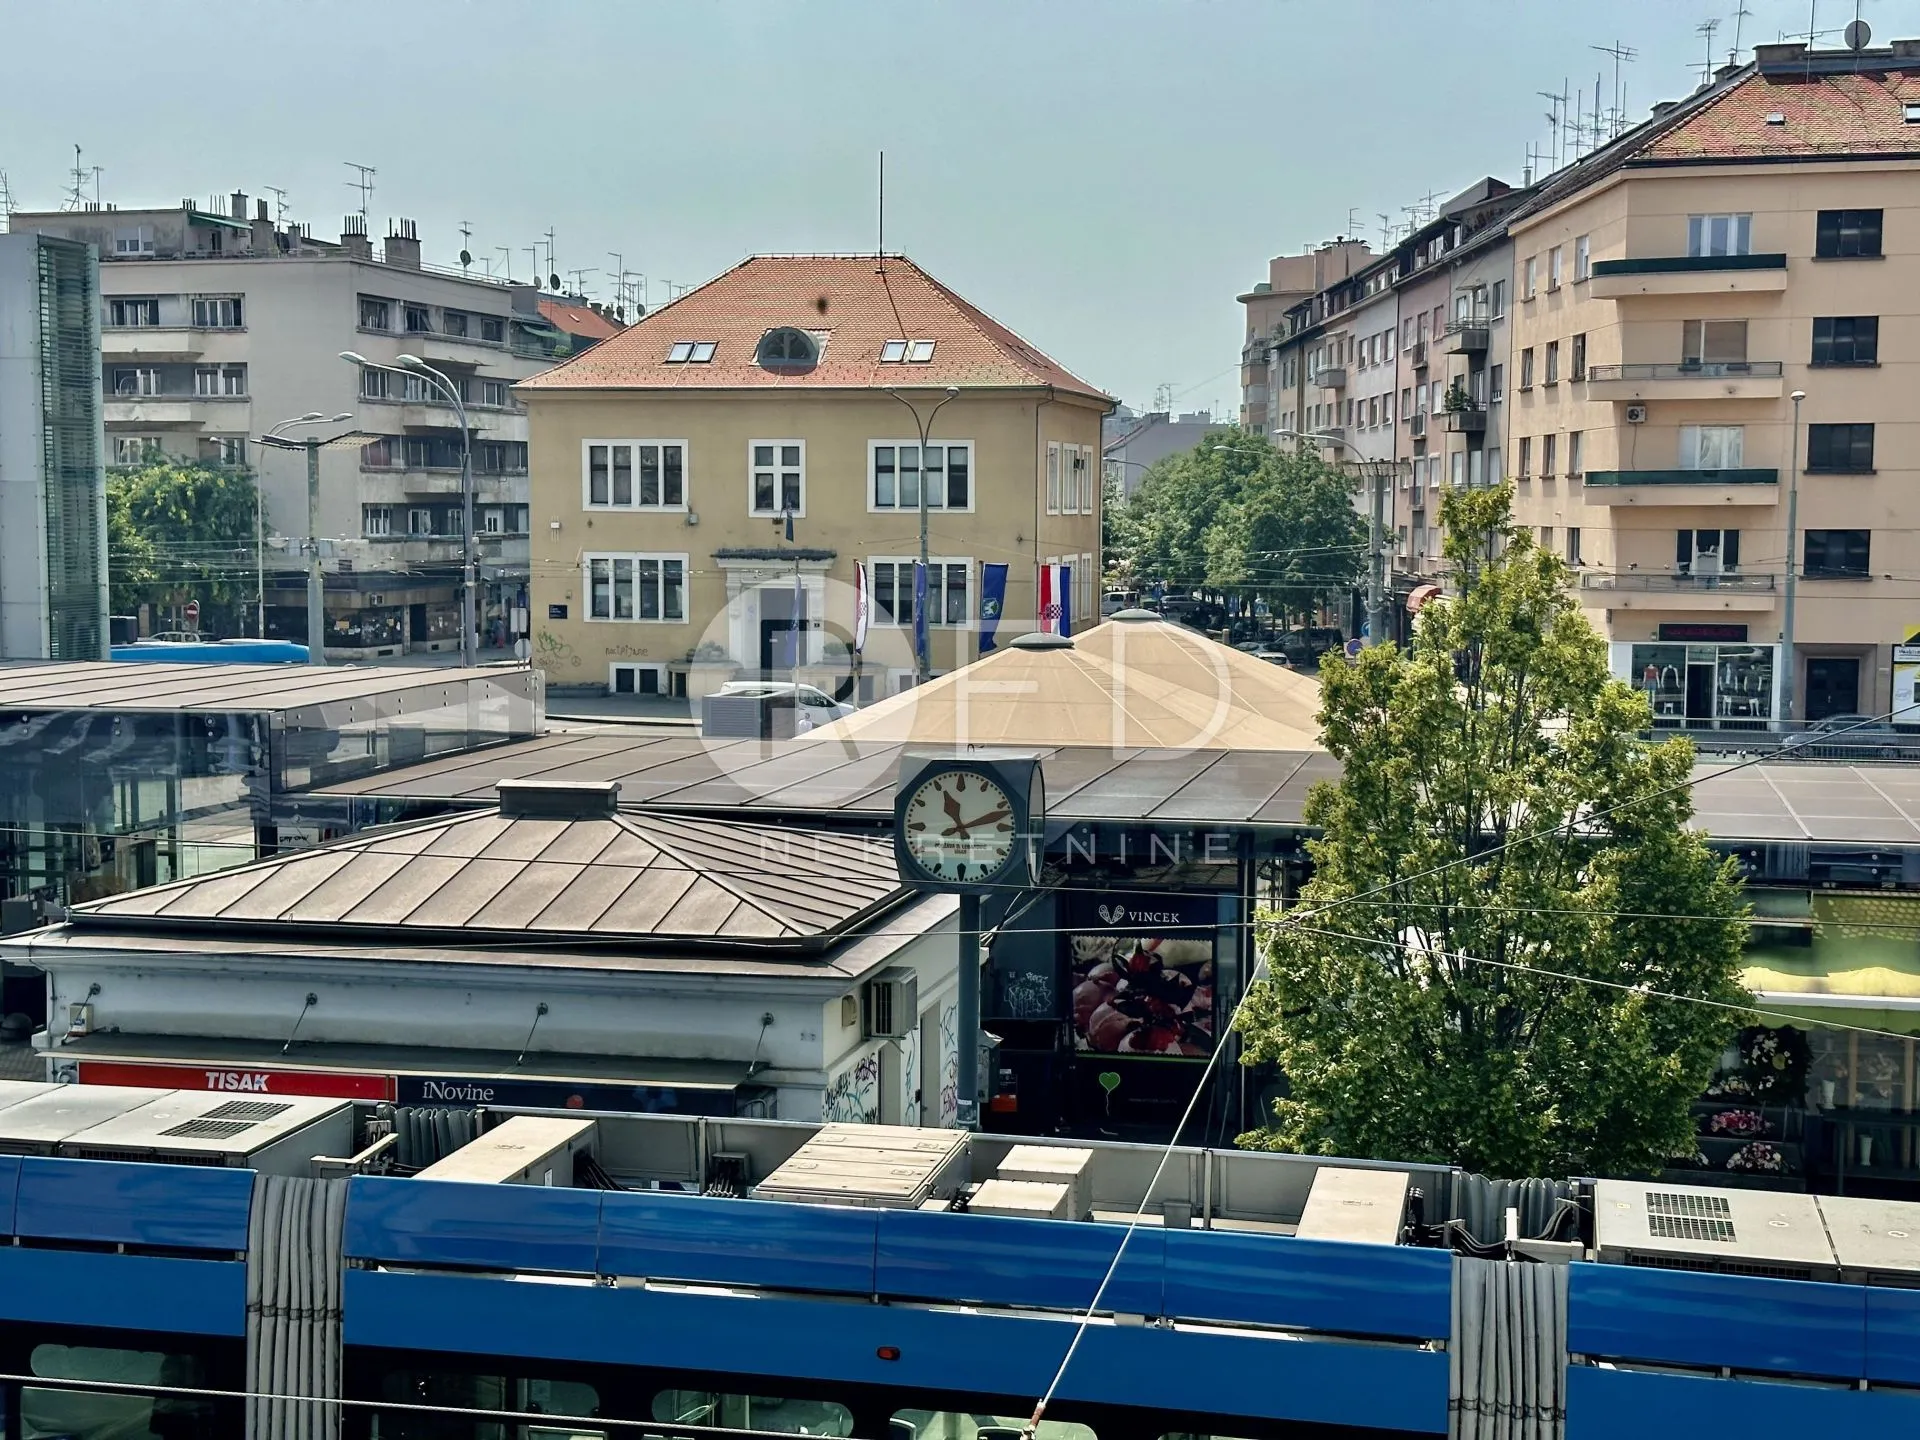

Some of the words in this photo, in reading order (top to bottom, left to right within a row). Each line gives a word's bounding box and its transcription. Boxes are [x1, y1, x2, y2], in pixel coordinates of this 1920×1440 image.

[1128, 911, 1180, 923] VINCEK
[206, 1071, 268, 1091] TISAK
[422, 1081, 494, 1101] iNovine
